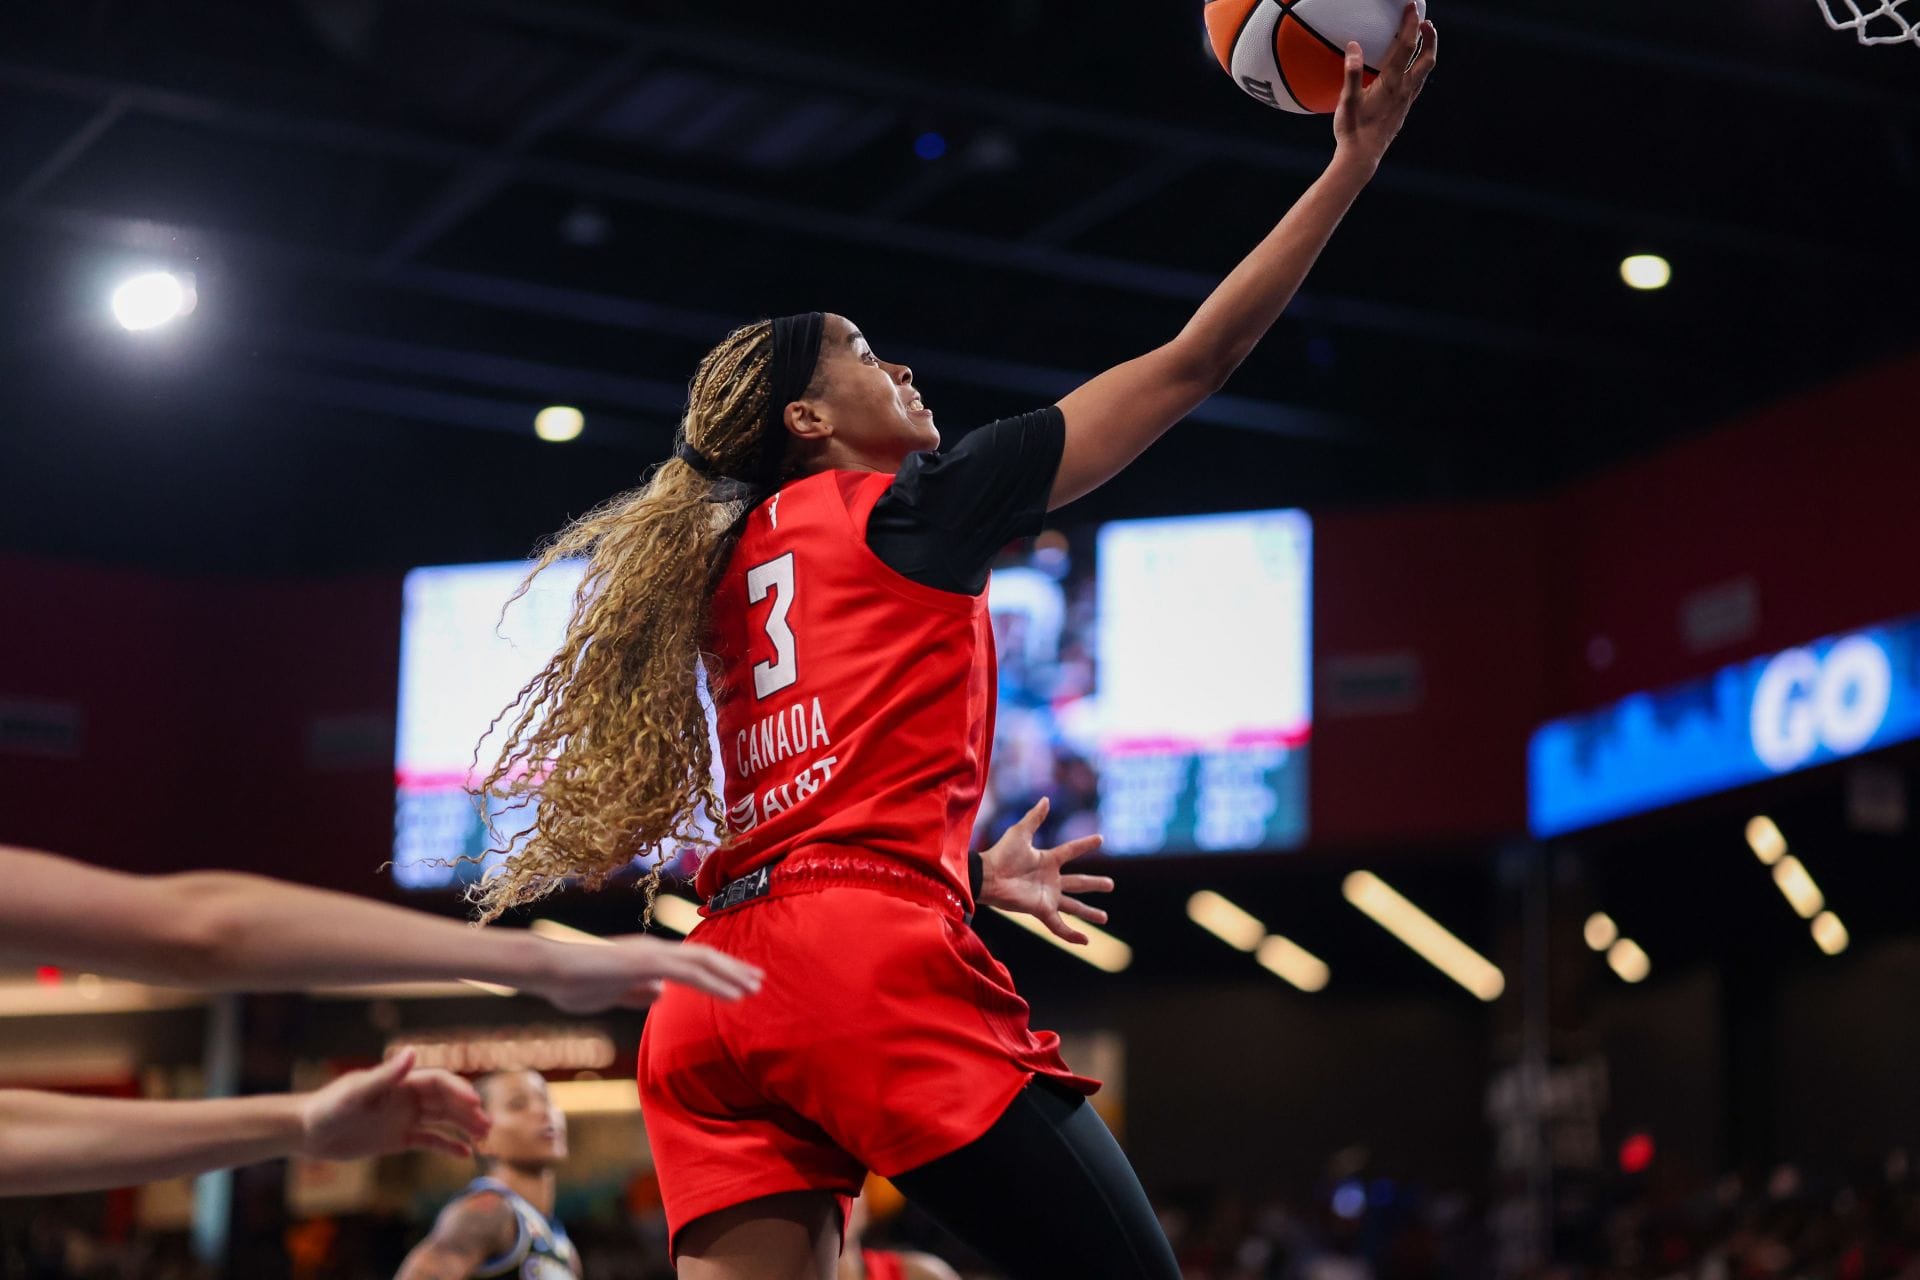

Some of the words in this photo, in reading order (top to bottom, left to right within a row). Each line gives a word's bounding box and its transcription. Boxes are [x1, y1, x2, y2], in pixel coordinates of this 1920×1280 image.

[747, 552, 797, 700] 3
[737, 697, 830, 778] CANADA
[1751, 635, 1891, 772] GO
